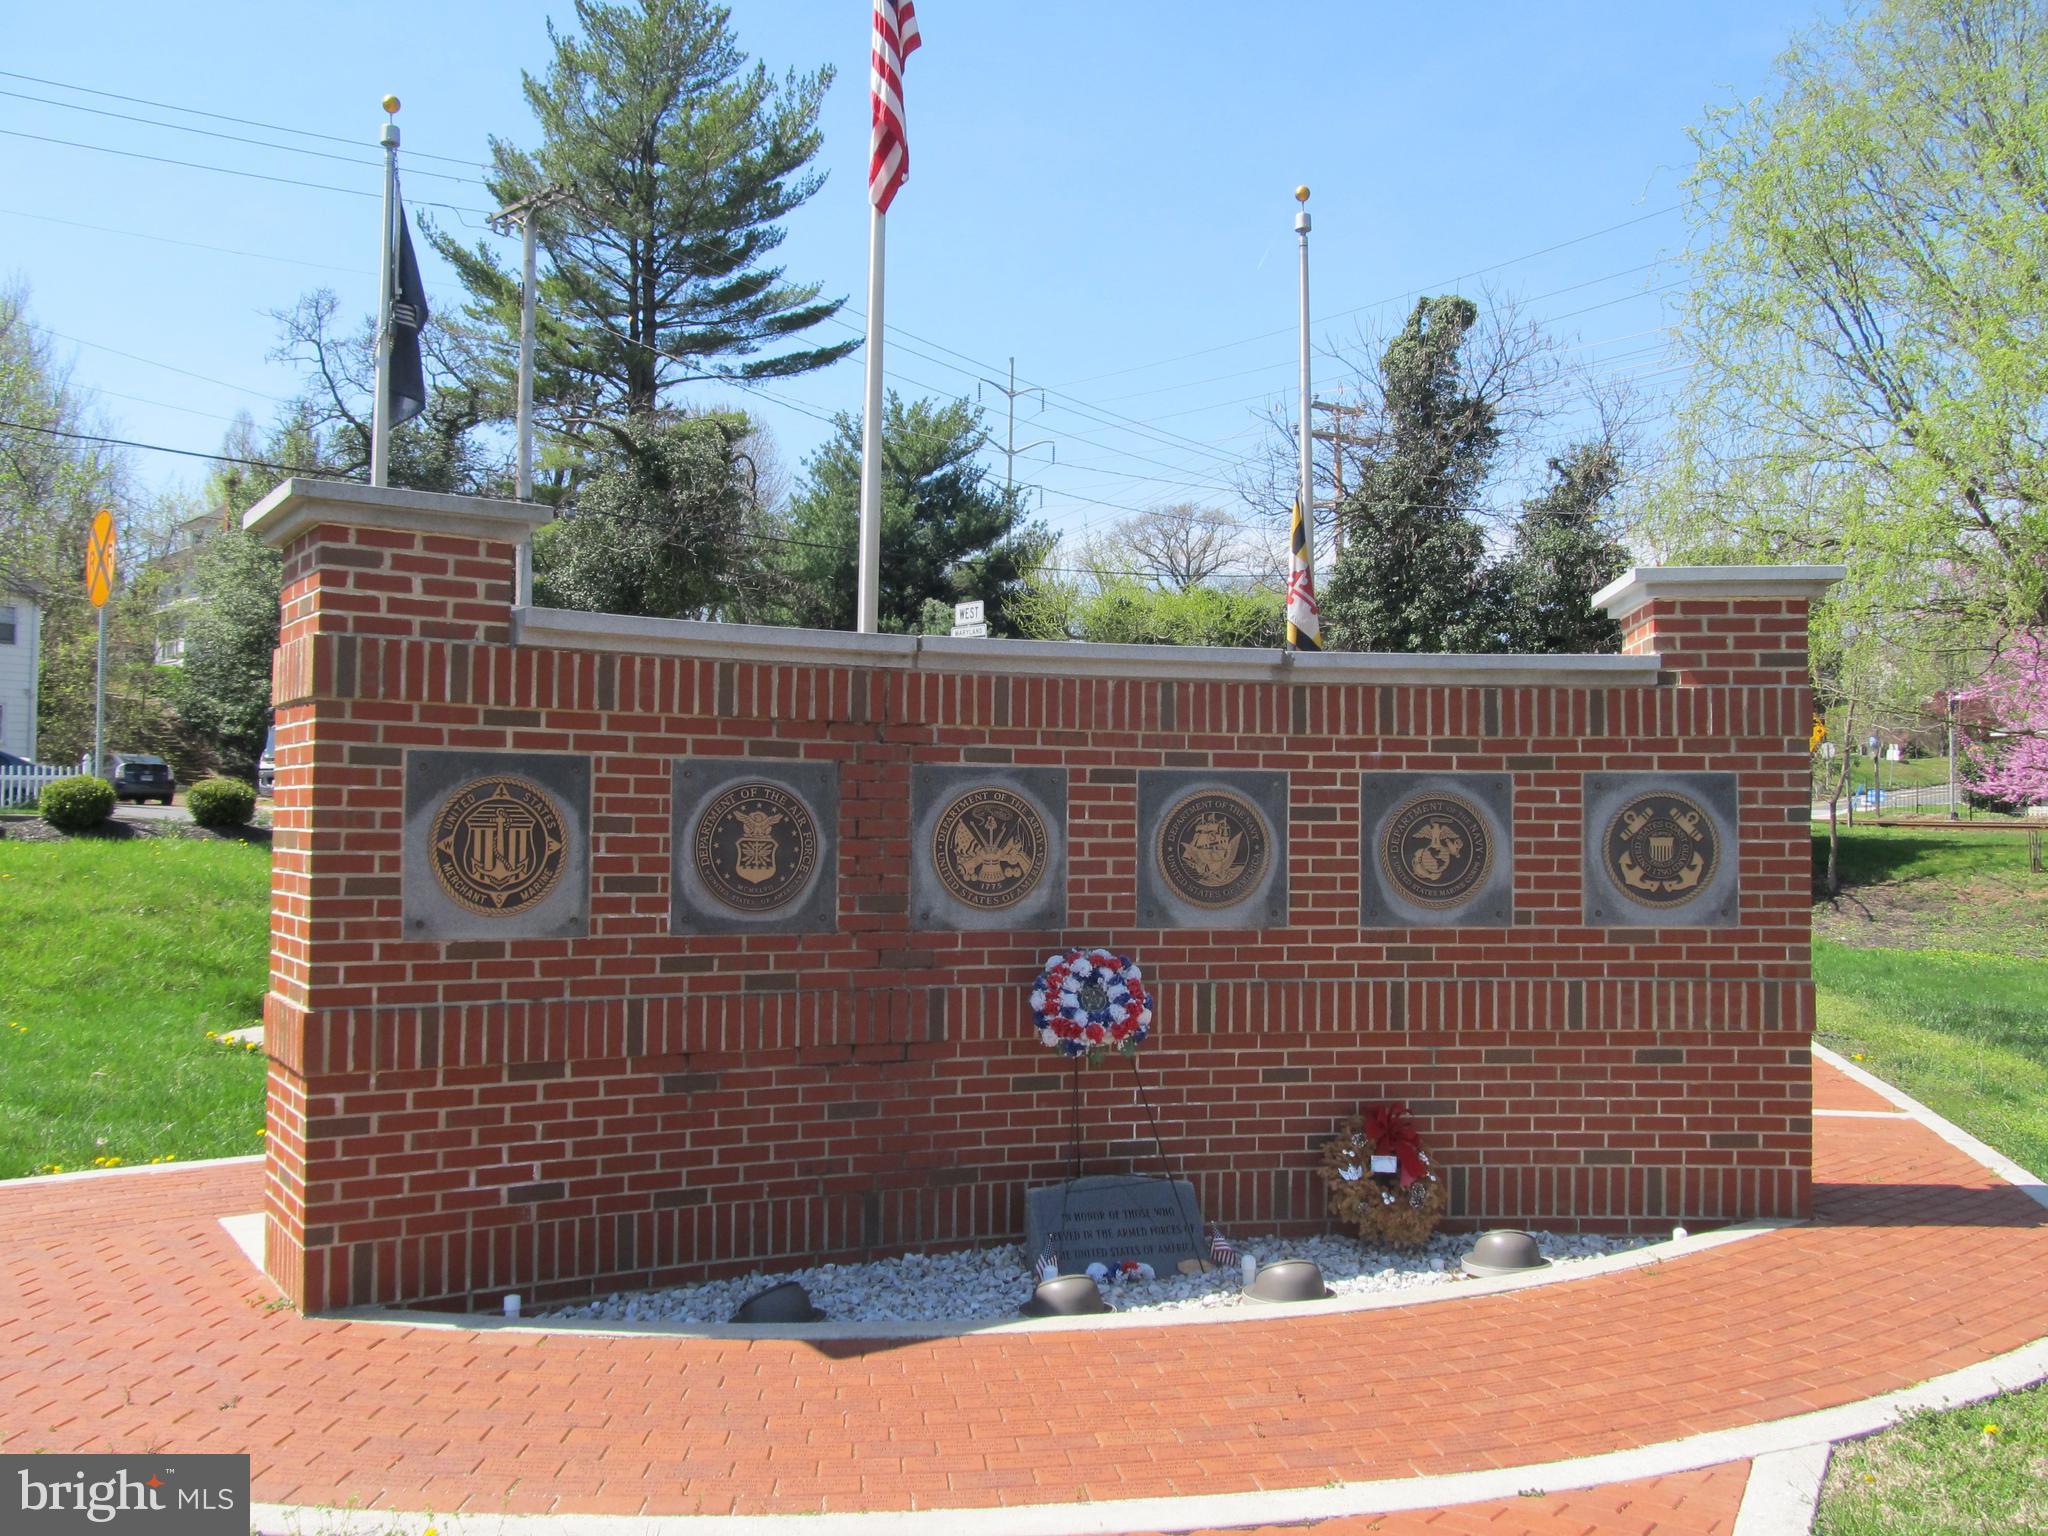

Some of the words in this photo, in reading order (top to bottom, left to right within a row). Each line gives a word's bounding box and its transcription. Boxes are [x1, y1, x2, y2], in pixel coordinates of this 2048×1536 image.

[960, 606, 978, 620] WEST
[954, 628, 982, 636] MARYLAND
[443, 793, 477, 830] UNITED
[523, 793, 557, 830] STATES
[938, 792, 988, 842] DEPARTMENT
[994, 792, 1006, 801] OF
[1010, 798, 1028, 814] THE
[1028, 815, 1044, 845] ARMY
[1168, 801, 1212, 841] DEPARTMENT
[1230, 804, 1246, 819] THE
[1244, 818, 1259, 840] NAVY
[699, 793, 736, 866] DEPARTMENT
[741, 788, 757, 799] OF
[764, 789, 788, 805] THE
[789, 805, 806, 827] AIR
[799, 832, 813, 873] FORCE
[1391, 802, 1443, 853] DEPARTMENT
[1471, 824, 1484, 854] NAVY
[443, 841, 453, 850] W
[547, 841, 553, 852] E
[938, 852, 959, 890] UNITED
[961, 890, 999, 904] STATES
[1002, 892, 1017, 902] OF
[1017, 852, 1044, 896] AMERICA
[1167, 855, 1188, 886] UNITED
[440, 862, 488, 904] MERCHANT
[520, 867, 554, 901] MARINE
[496, 893, 503, 904] S
[1074, 1209, 1105, 1222] HONOR
[1108, 1209, 1120, 1220] OF
[1123, 1208, 1151, 1219] THOSE
[1154, 1207, 1175, 1217] WHO
[1083, 1230, 1094, 1241] IN
[1097, 1229, 1112, 1241] THE
[1117, 1226, 1147, 1238] ARMED
[1149, 1224, 1181, 1237] FORCES
[1074, 1247, 1107, 1258] UNITED
[1110, 1246, 1141, 1257] STATES
[1143, 1245, 1153, 1255] OF
